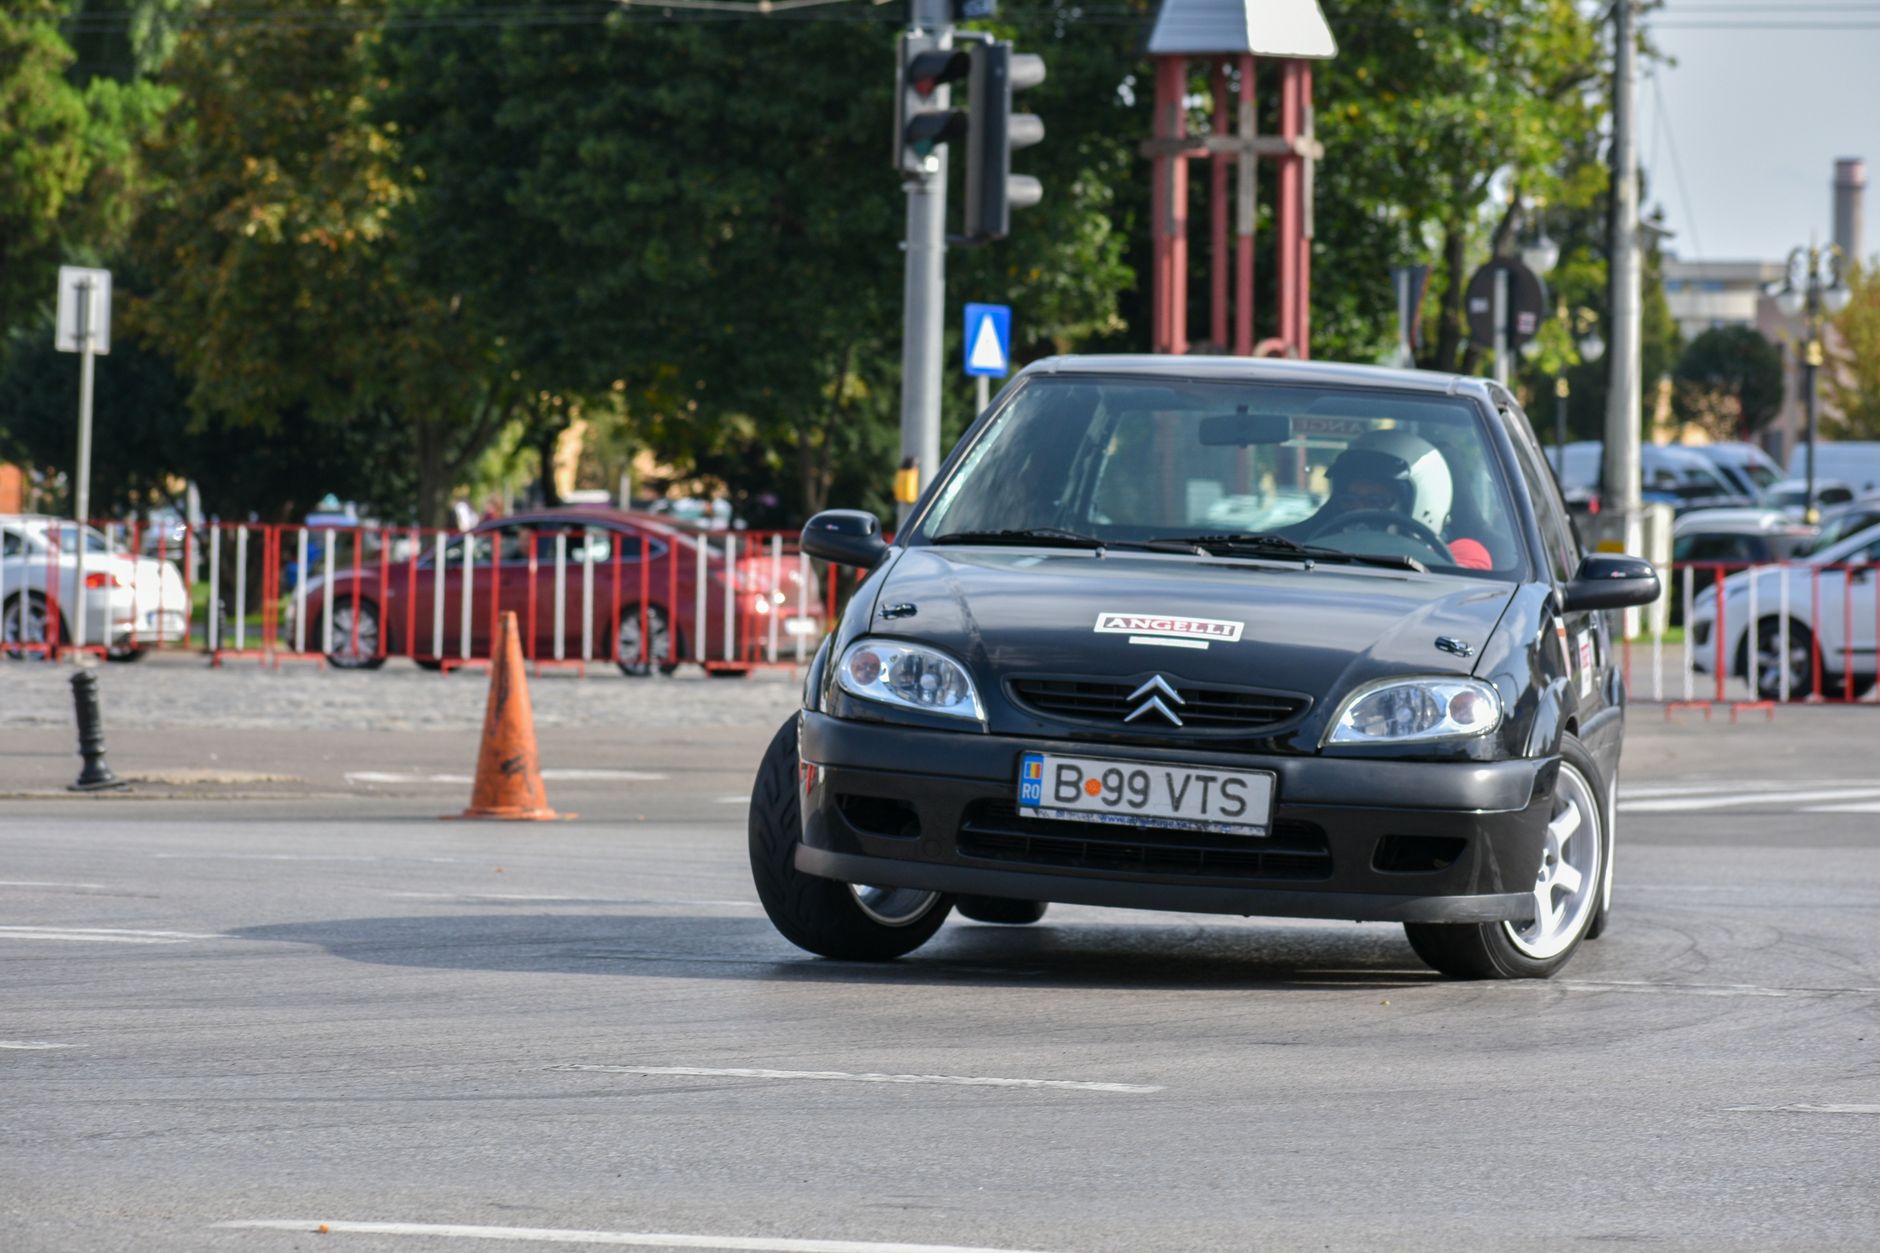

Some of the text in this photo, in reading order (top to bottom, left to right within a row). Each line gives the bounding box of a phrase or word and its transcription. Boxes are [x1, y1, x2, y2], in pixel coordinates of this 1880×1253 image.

[1106, 617, 1233, 637] ANGELLI
[1021, 782, 1041, 800] RO
[1053, 763, 1249, 818] B 99 VTS
